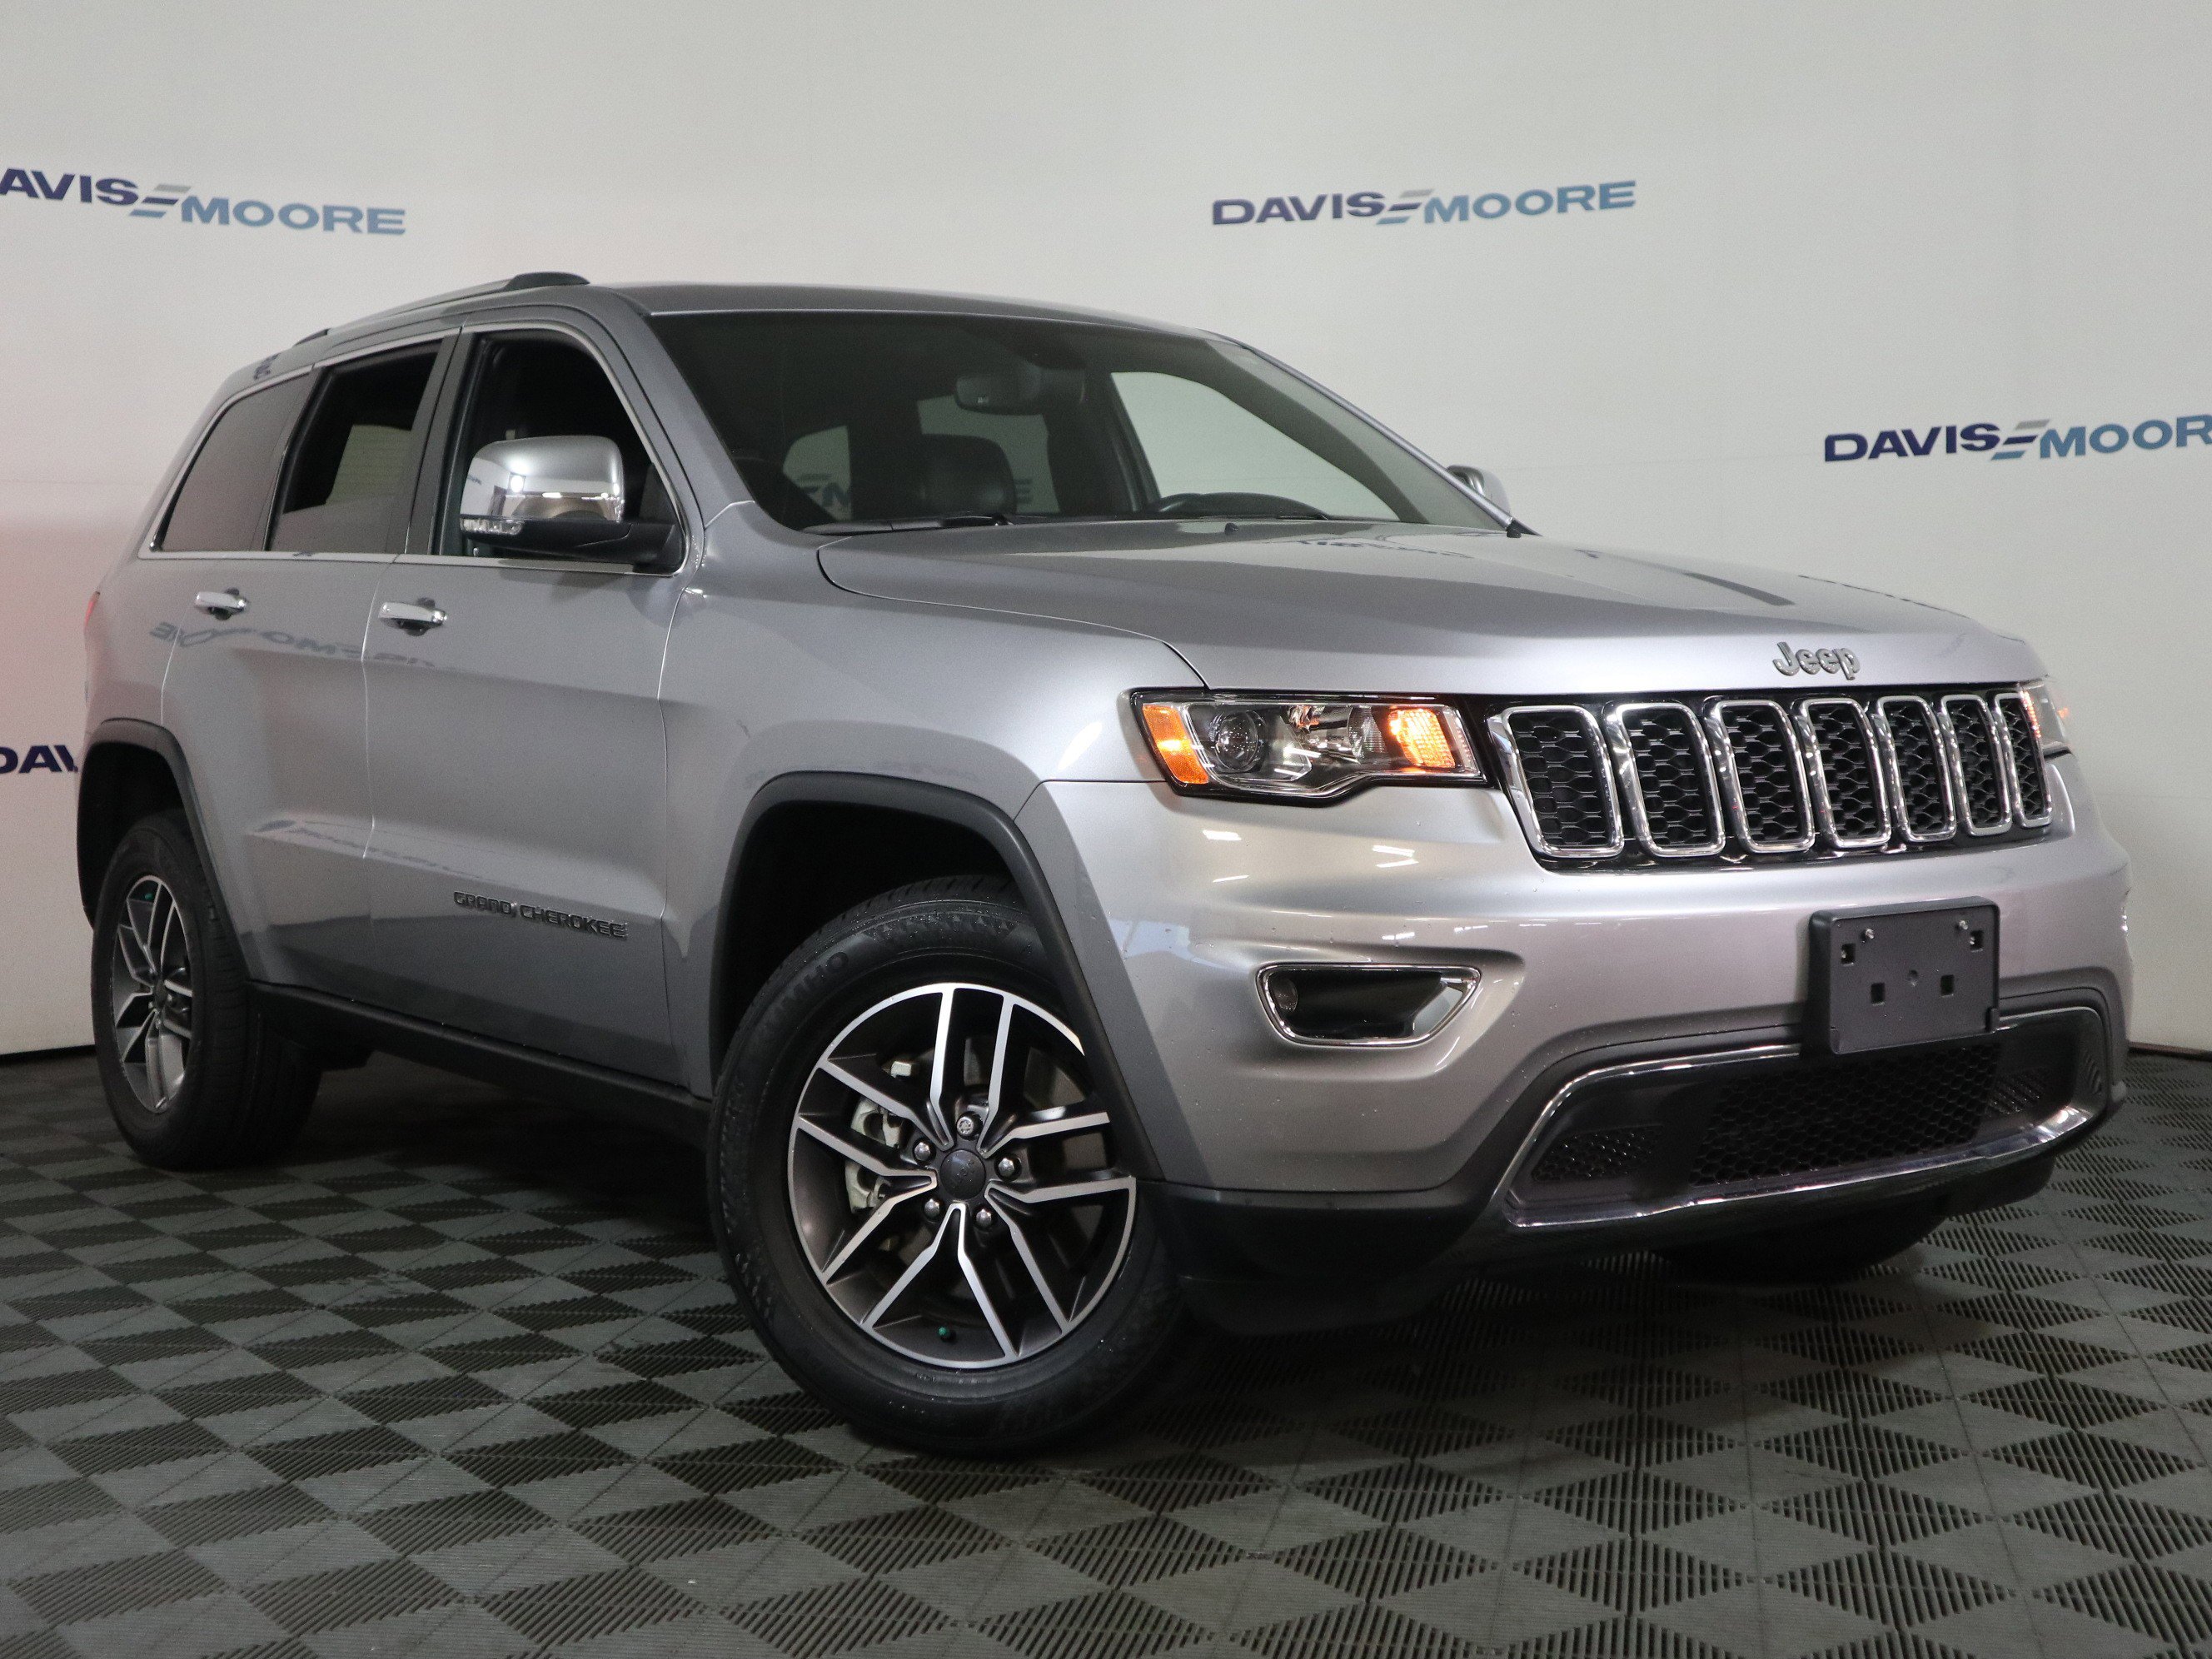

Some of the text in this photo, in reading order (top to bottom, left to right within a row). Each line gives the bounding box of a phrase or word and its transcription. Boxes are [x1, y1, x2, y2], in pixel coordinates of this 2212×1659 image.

[181, 195, 406, 235] MOORE
[1212, 180, 1637, 225] DAVIS MOORE
[1824, 422, 2000, 462] DAVIS
[1772, 641, 1861, 680] Jeep
[520, 904, 629, 939] CHEROKEE
